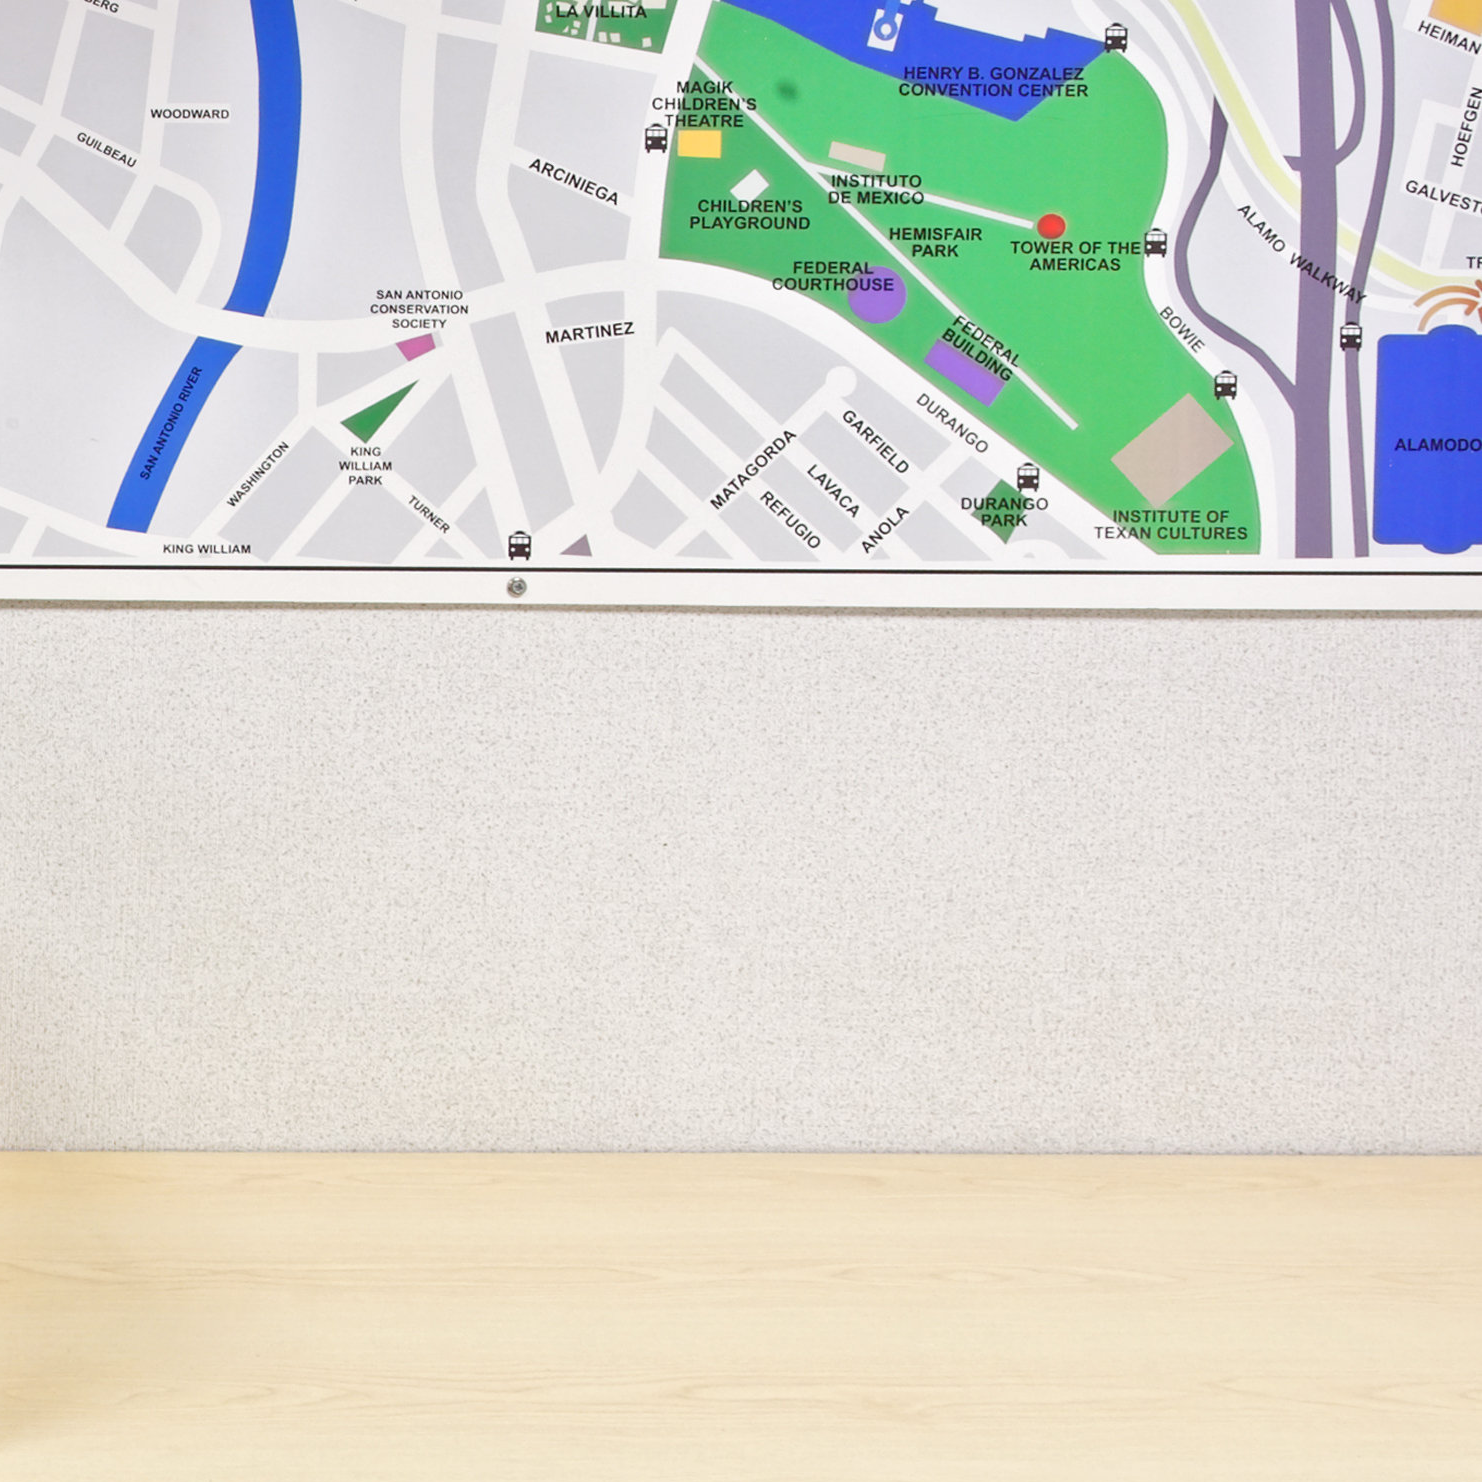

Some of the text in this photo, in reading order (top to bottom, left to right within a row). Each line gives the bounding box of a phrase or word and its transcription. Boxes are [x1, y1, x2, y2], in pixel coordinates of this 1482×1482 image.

[556, 5, 647, 17] LA VILLITA
[1419, 21, 1481, 54] HEIMAN
[904, 67, 1084, 80] HENRY B. GONZALEZ
[677, 81, 732, 93] MAGIK
[899, 83, 1088, 96] CONVENTION CENTER
[151, 109, 229, 119] WOODWARD
[665, 114, 743, 127] THEATRE
[1451, 87, 1482, 167] HOEFGEN
[77, 133, 137, 167] GUILBEAU
[529, 159, 617, 205] ARCINIEGA
[831, 174, 921, 187] INSTITUTO
[829, 191, 924, 204] DE MEXICO
[1406, 180, 1482, 213] GALVEST
[690, 216, 810, 229] PLAYGROUND
[890, 228, 982, 240] HEMISFAIR
[912, 244, 958, 257] PARK
[1011, 241, 1140, 254] TOWER OF THE
[1238, 206, 1369, 306] ALAMO WALKWAY
[794, 261, 873, 274] FEDERAL
[1030, 258, 1120, 271] AMERICAS
[772, 278, 893, 291] COURTHOUSE
[377, 290, 463, 300] SAN ANTONIO
[371, 304, 468, 314] CONSERVATION
[393, 319, 446, 328] SOCIETY
[1160, 306, 1205, 352] BOWIE
[546, 322, 634, 343] MARTINEZ
[953, 316, 1019, 368] FEDERAL
[941, 328, 1013, 382] BUILDING
[140, 366, 203, 479] SAN ANTONIO RIVER
[917, 393, 988, 453] DURANGO
[843, 411, 909, 473] GARFIELD
[1395, 438, 1482, 451] ALAMODO
[351, 447, 381, 456] KING
[339, 462, 392, 470] WILLIAM
[710, 430, 797, 510] MATAGORDA
[227, 442, 289, 506] WASHINGTON
[349, 476, 382, 484] PARK
[807, 465, 859, 517] LAVACA
[961, 498, 1048, 510] DURANGO
[409, 495, 450, 533] TURNER
[760, 491, 820, 548] REFUGIO
[982, 514, 1027, 527] PARK
[1114, 510, 1229, 523] INSTITUTE OF
[862, 508, 909, 553] ANOLA
[1095, 527, 1247, 540] TEXAN CULTURES
[163, 545, 250, 553] KING WILLIAM
